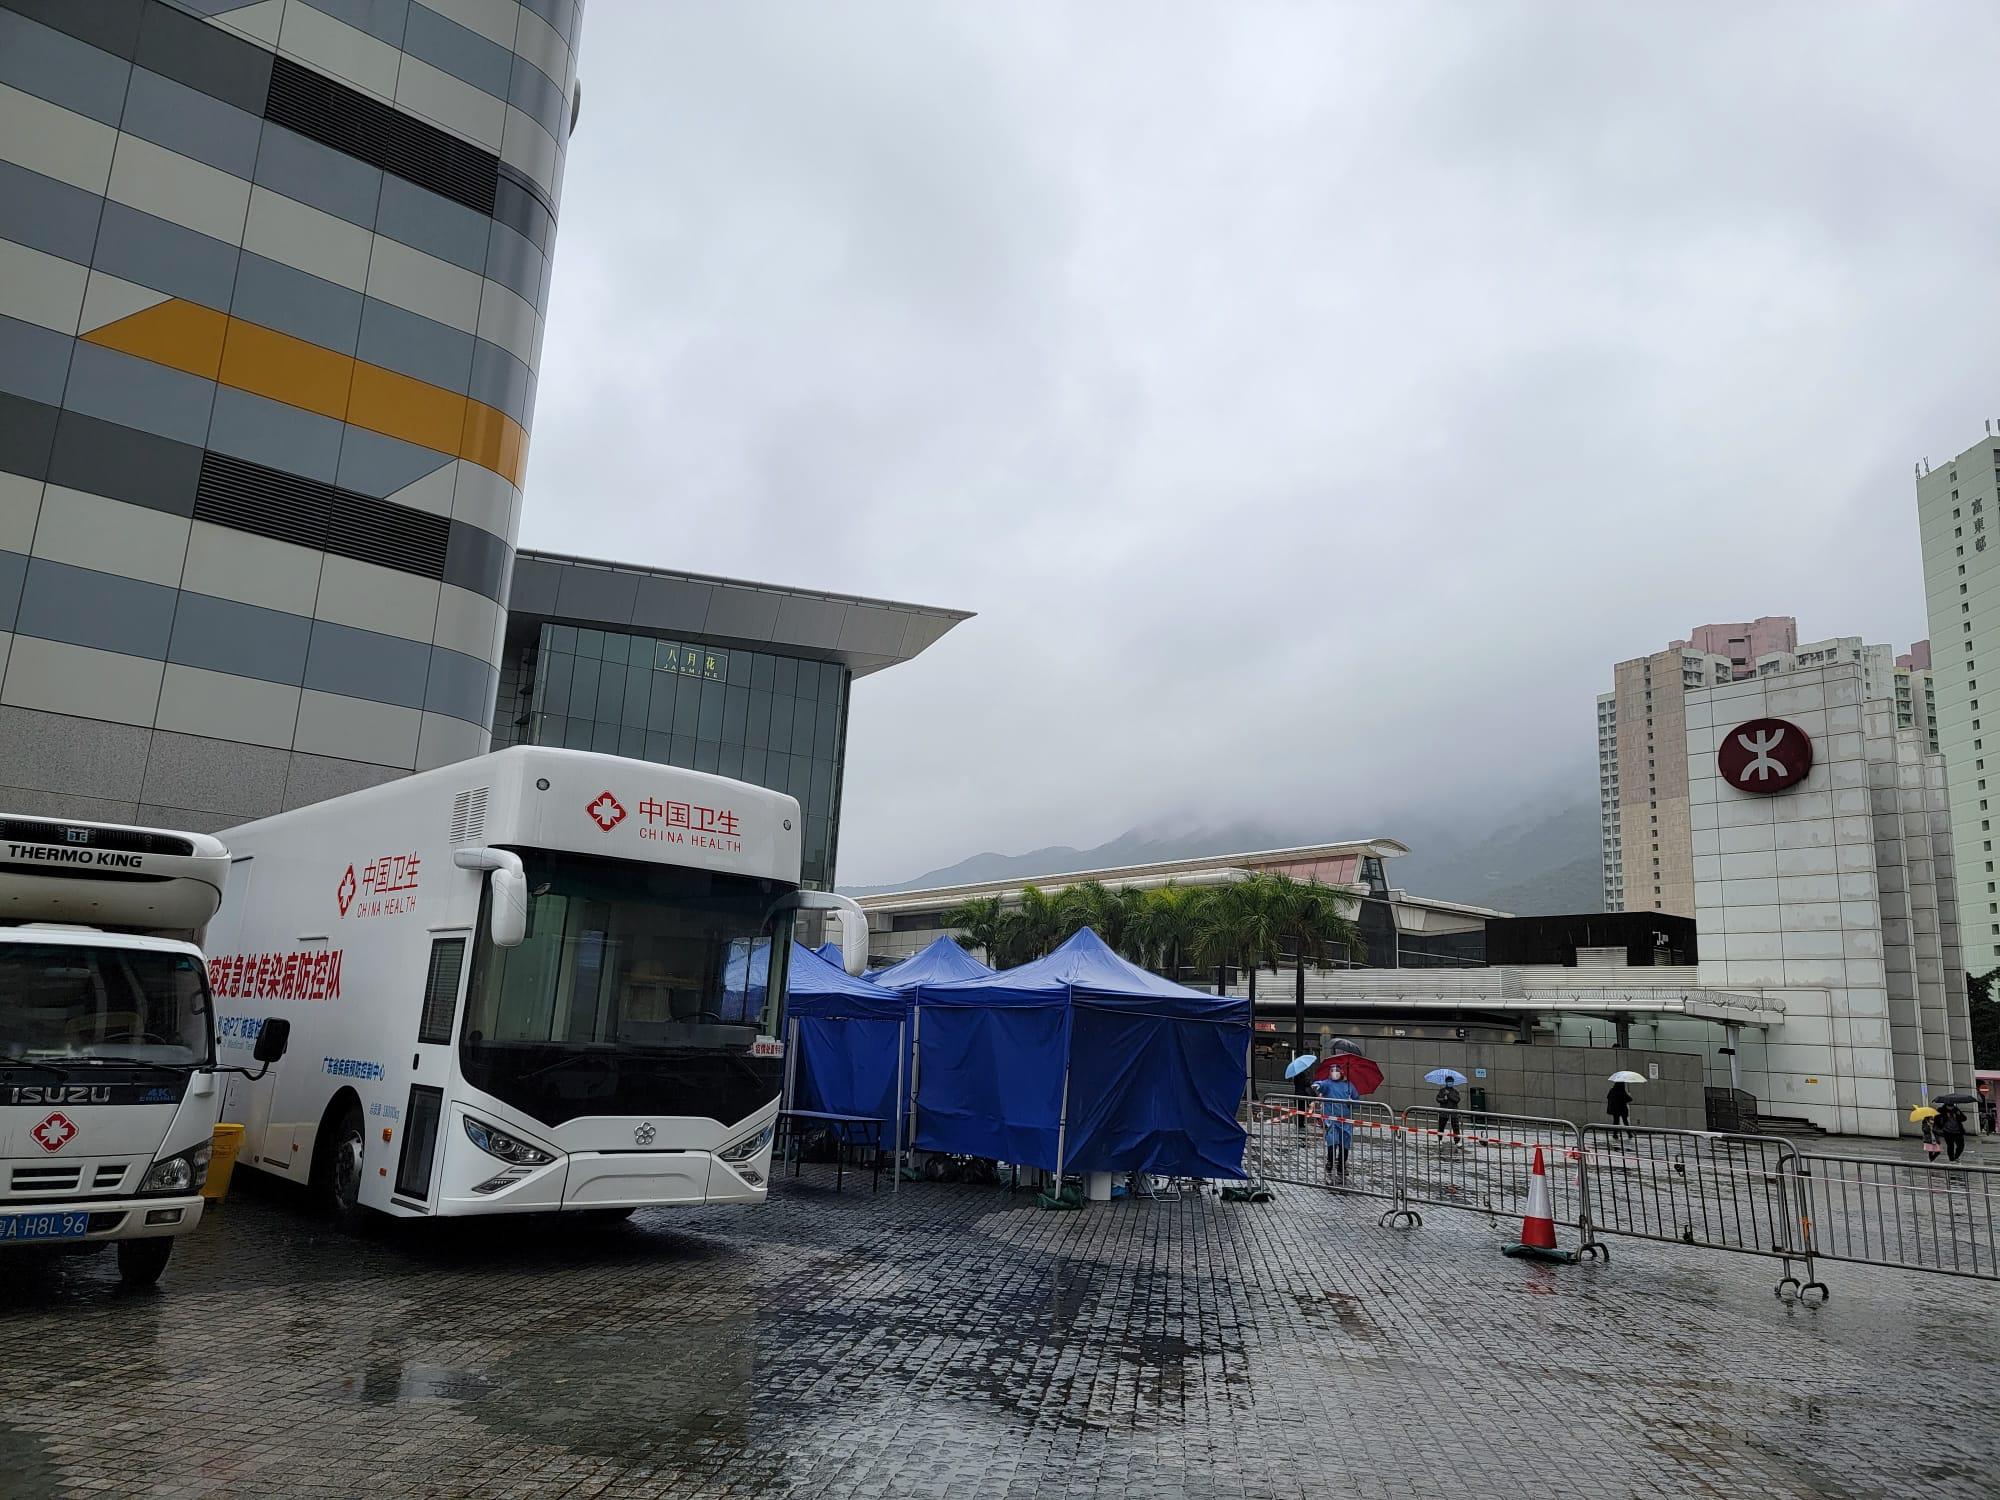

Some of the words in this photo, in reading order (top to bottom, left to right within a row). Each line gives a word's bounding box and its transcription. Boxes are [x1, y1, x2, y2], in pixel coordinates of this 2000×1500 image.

[663, 663, 719, 679] JASMINE
[667, 648, 716, 671] 八月花
[639, 797, 741, 837] 中国卫生
[639, 827, 684, 844] CHINA
[691, 834, 742, 853] HEALTH
[8, 844, 94, 864] THERMO
[96, 852, 143, 868] KING
[362, 850, 421, 897] 中国卫生
[357, 900, 381, 918] CHINA
[384, 895, 417, 915] HEALTH
[209, 949, 343, 1001] 突发急性传染病防控队
[11, 1086, 112, 1104] ISUZU
